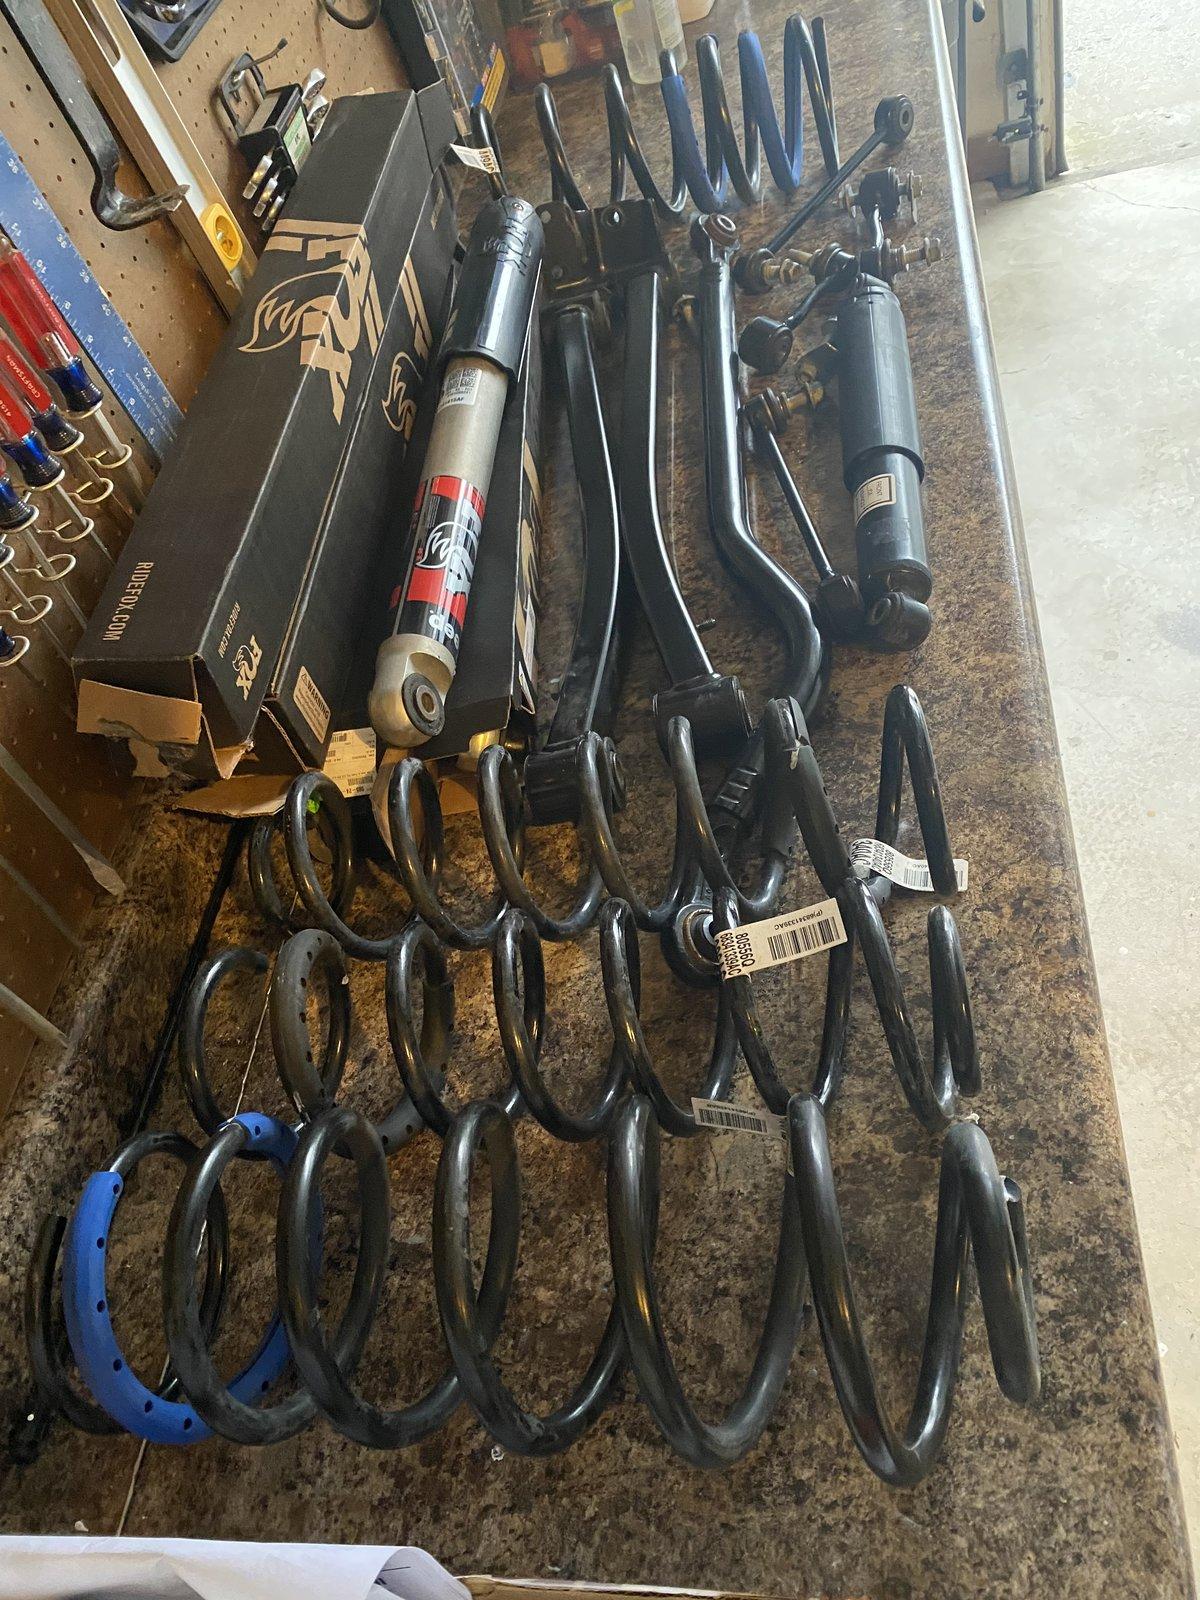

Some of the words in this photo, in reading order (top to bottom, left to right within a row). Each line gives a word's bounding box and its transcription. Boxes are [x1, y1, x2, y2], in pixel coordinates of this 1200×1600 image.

[36, 259, 47, 274] 10
[7, 354, 41, 399] CRAFTSMAN
[102, 561, 154, 641] RIDEFOX.COM
[217, 602, 241, 659] RIDEFOX.COM
[232, 634, 263, 701] FOX
[307, 682, 330, 720] WARNING
[719, 932, 742, 976] 68341339AC
[735, 932, 756, 967] 80556Q
